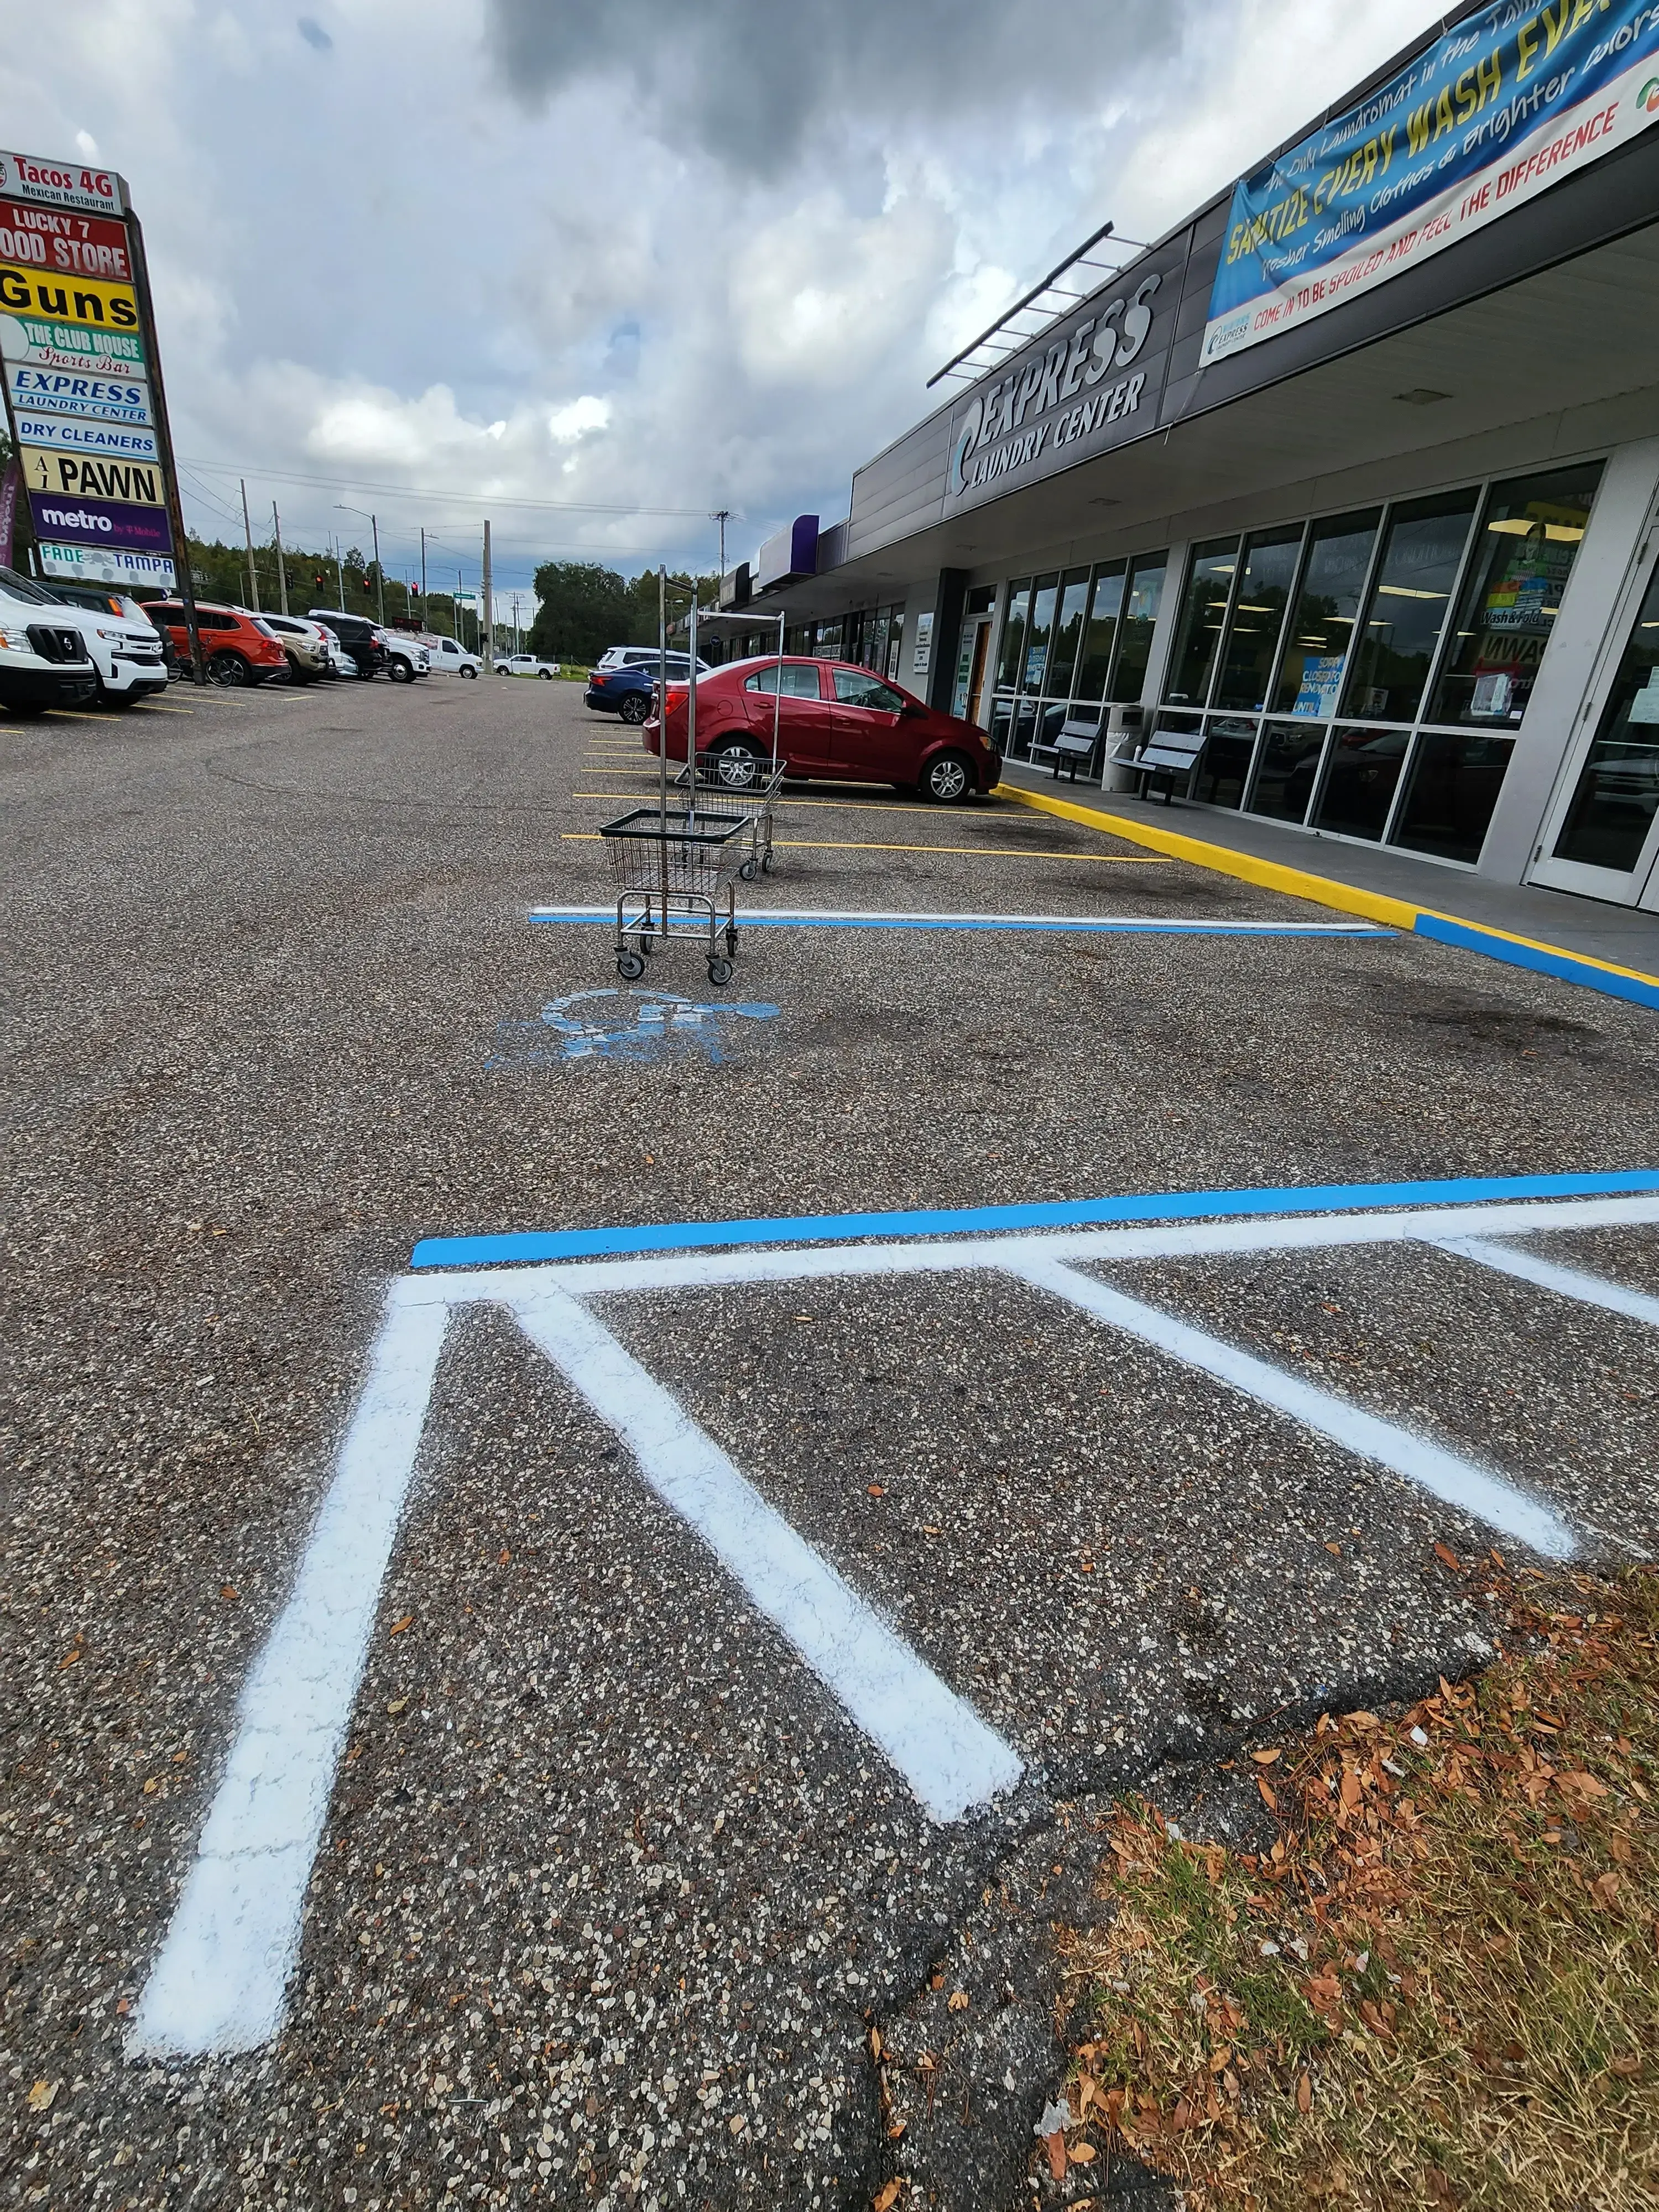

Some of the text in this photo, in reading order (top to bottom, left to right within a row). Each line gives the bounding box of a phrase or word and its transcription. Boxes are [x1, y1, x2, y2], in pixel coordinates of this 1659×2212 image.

[1287, 147, 1317, 178] Only
[1319, 73, 1418, 158] Laundromat
[1420, 61, 1436, 87] in
[1441, 30, 1480, 68] the
[1313, 123, 1397, 215] EVERY
[1407, 46, 1502, 159] WASH
[1515, 0, 1610, 82] EVE
[13, 156, 113, 197] Tacos 4G
[1312, 205, 1366, 254] Smelling
[1370, 160, 1436, 214] Clothes
[1438, 143, 1457, 169] &
[1463, 66, 1575, 155] Brighter
[22, 184, 114, 211] Mexican Restaurant
[12, 208, 90, 239] LUCKY 7
[1254, 304, 1283, 331] COME
[1282, 295, 1295, 318] IN
[1297, 287, 1310, 311] TO
[1312, 278, 1327, 304] BE
[1329, 250, 1385, 295] SPOILED
[1384, 229, 1418, 267] AND
[1417, 209, 1453, 248] FEEL
[1460, 180, 1492, 222] THE
[1495, 102, 1620, 201] DIFFERENCE
[0, 227, 128, 278] OOD STORE
[0, 269, 137, 327] Guns
[24, 322, 140, 358] THE CLUB HOUSE
[1218, 323, 1249, 344] EXPRESS
[39, 345, 131, 374] Sports Bar
[977, 274, 1162, 449] EXPRESS
[16, 370, 142, 405] EXPRESS
[19, 394, 147, 422] LAUNDRY CENTER
[21, 421, 154, 451] DRY CLEANERS
[970, 372, 1147, 489] LAUNDRY CENTER
[34, 455, 49, 472] A
[58, 457, 158, 503] PAWN
[40, 474, 50, 489] 1
[42, 507, 113, 533] metro
[41, 545, 174, 574] FADE TAMPA
[1299, 682, 1337, 695] RENOVATIO
[1330, 670, 1341, 682] FO
